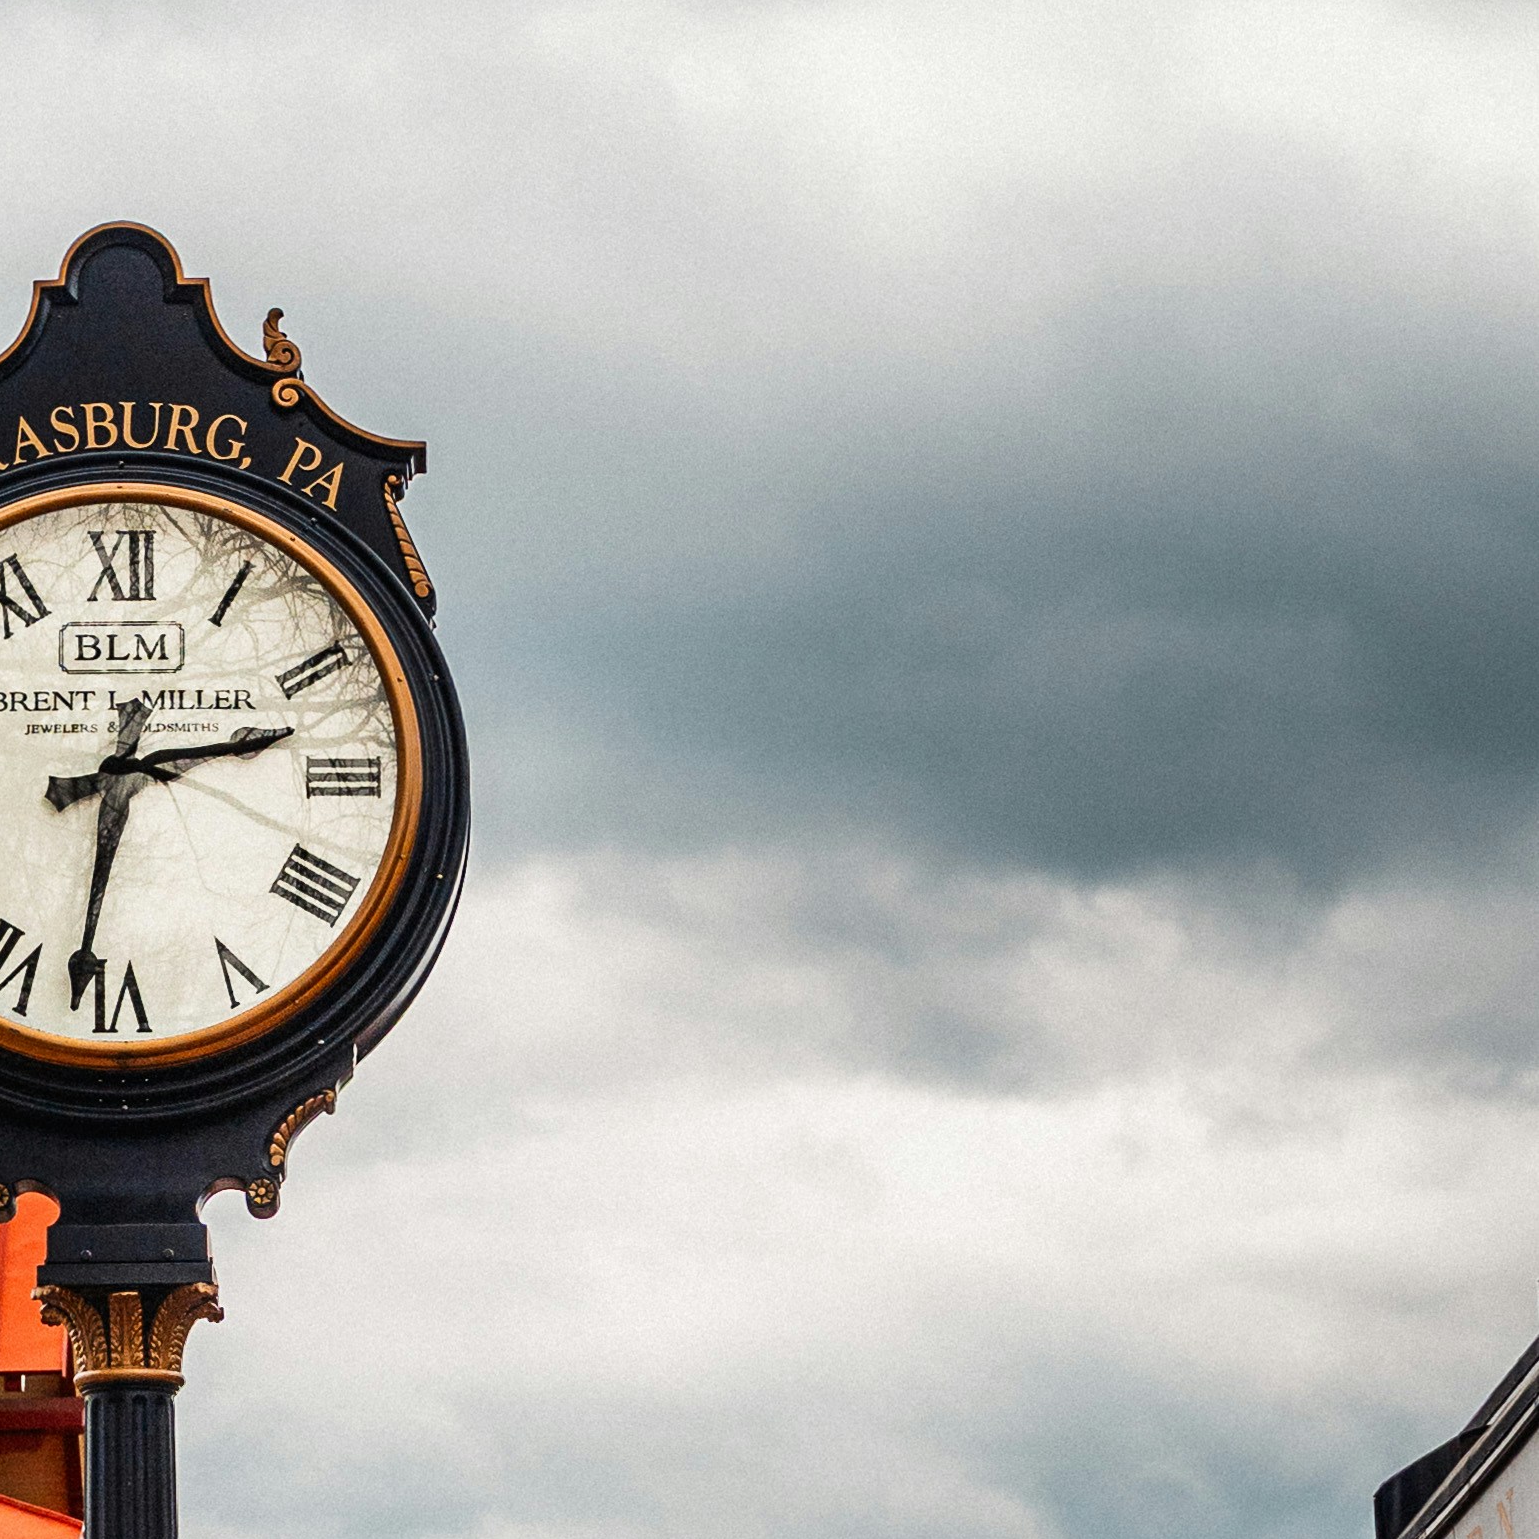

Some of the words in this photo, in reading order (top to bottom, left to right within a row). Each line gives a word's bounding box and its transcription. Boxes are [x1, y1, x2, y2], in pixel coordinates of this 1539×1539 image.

[276, 436, 347, 512] PA
[86, 529, 156, 601] XII
[208, 559, 256, 628] I
[74, 633, 169, 662] BLM
[274, 639, 353, 701] II
[24, 722, 99, 736] JEWELERS
[106, 721, 122, 733] &
[142, 689, 257, 711] MILLER
[306, 756, 382, 800] III
[269, 842, 362, 928] IIII
[91, 959, 153, 1033] VI
[214, 935, 271, 1010] V
